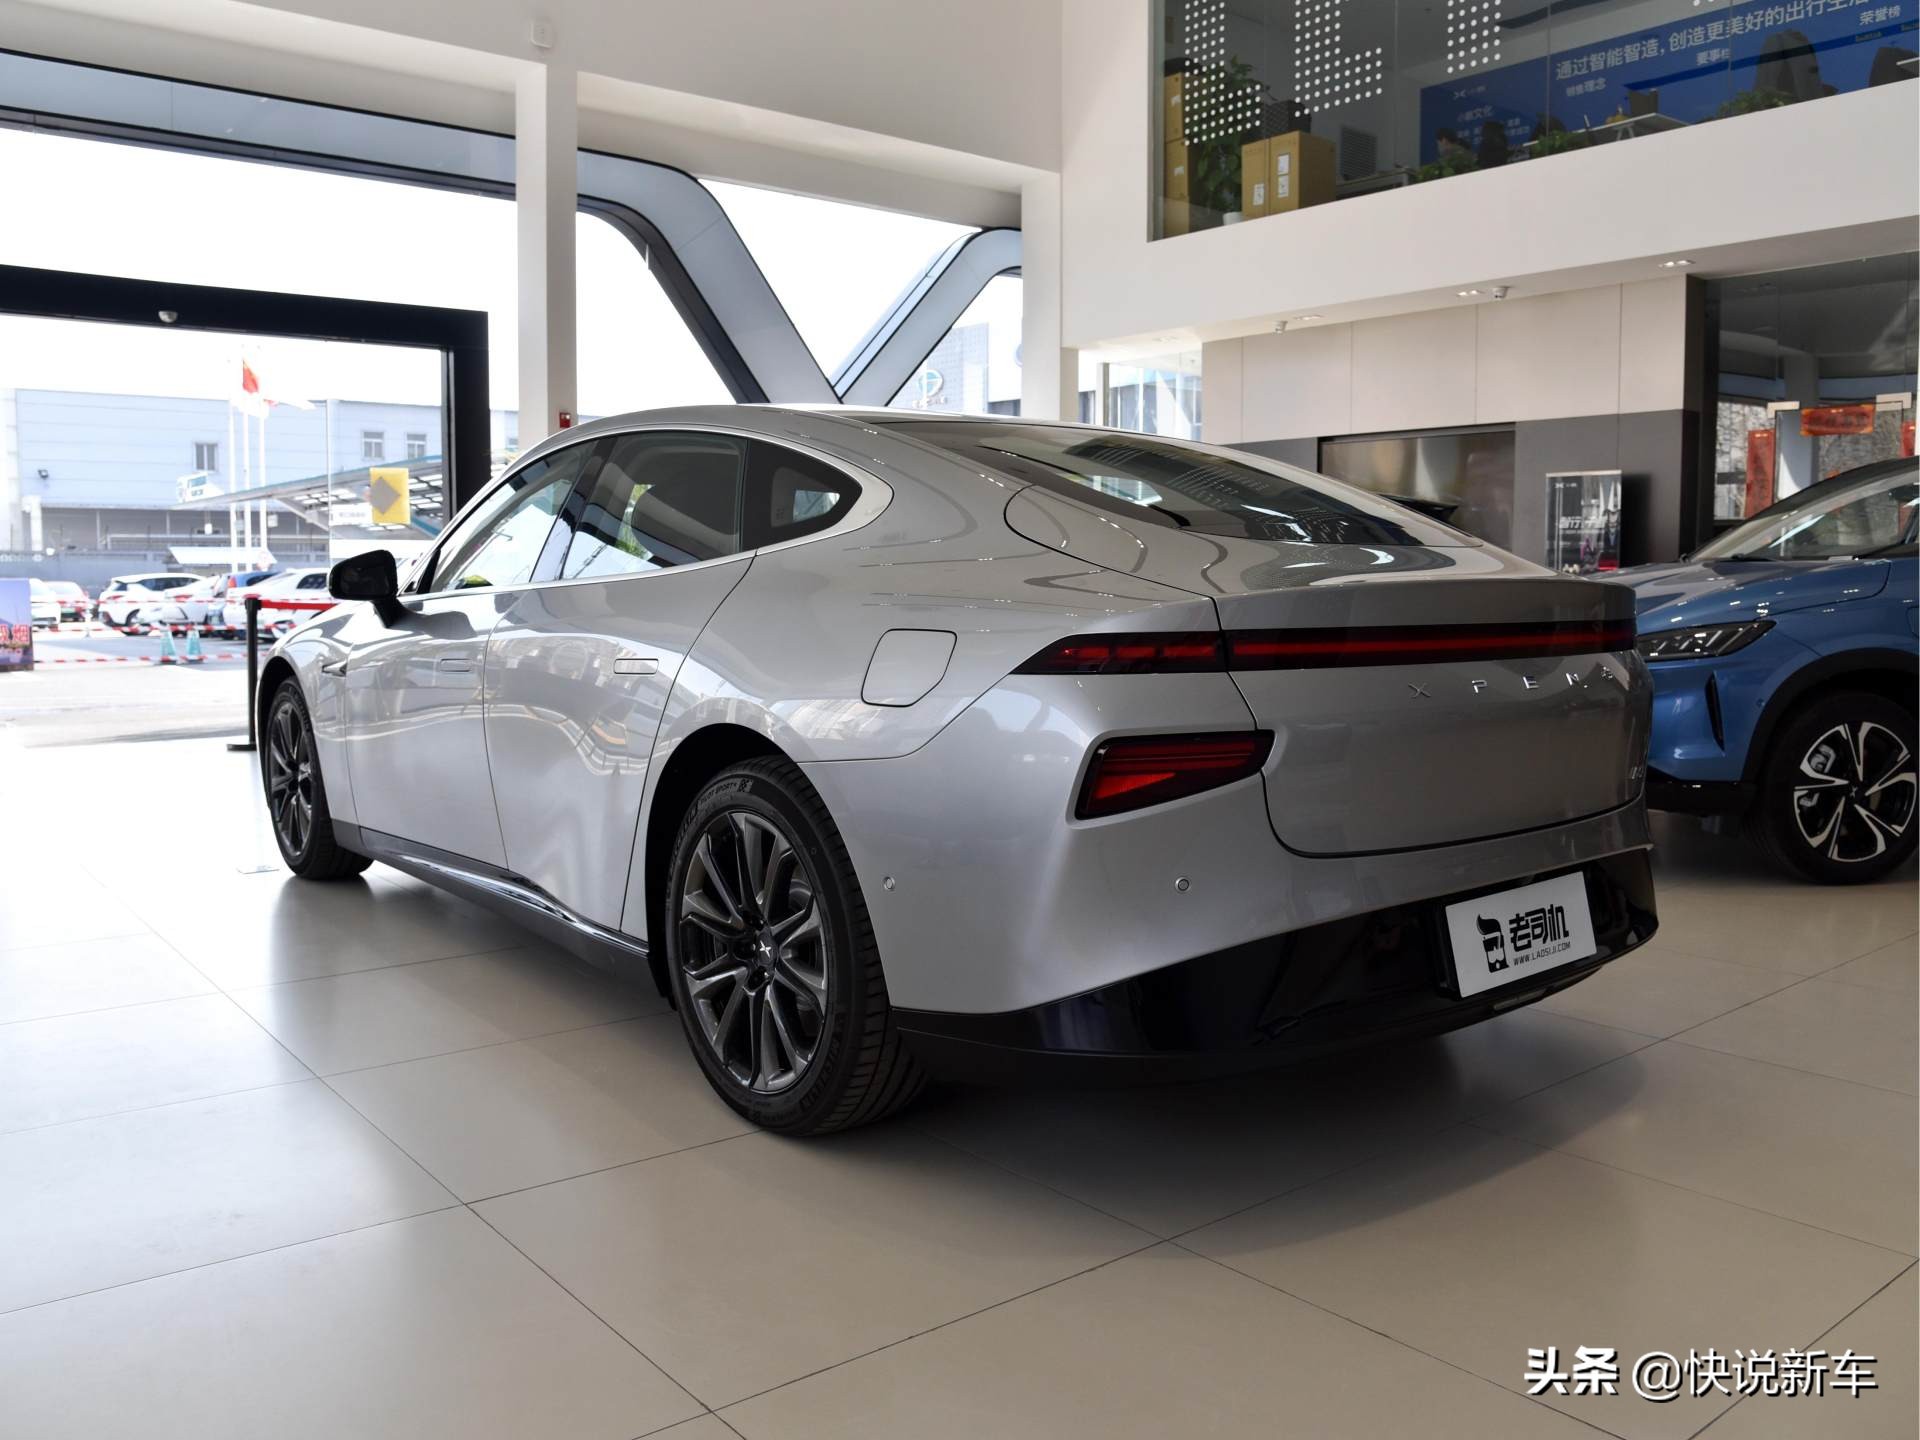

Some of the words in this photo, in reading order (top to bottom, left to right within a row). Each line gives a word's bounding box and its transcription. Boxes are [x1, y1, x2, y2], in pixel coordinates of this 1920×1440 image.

[1859, 5, 1900, 26] 荣誉榜
[1509, 904, 1569, 952] 老司机
[1513, 941, 1571, 966] WWW.LAOSIJI.COM
